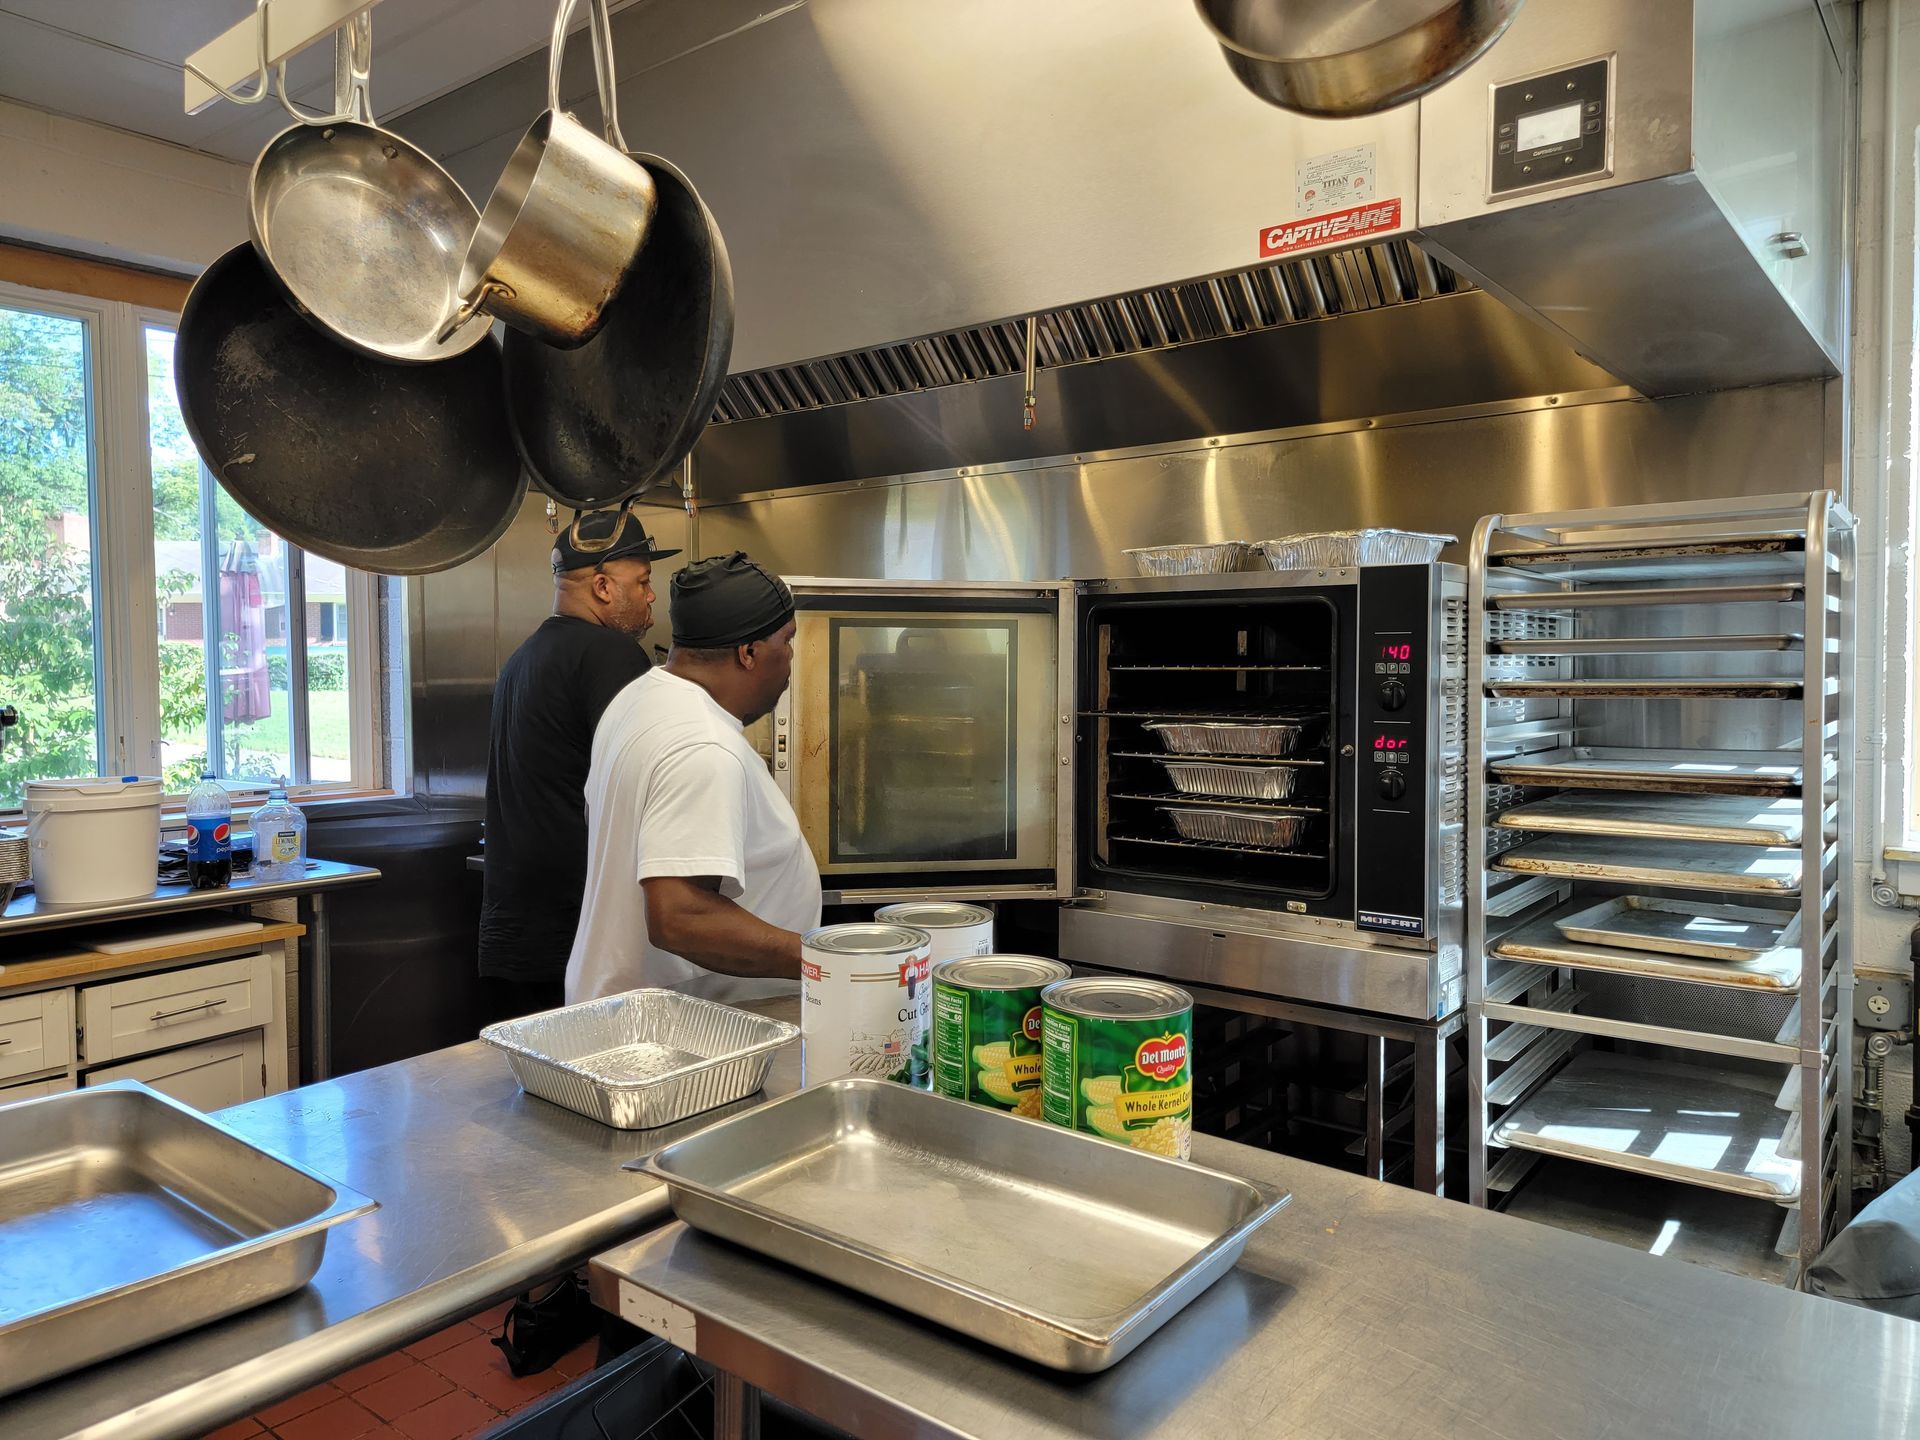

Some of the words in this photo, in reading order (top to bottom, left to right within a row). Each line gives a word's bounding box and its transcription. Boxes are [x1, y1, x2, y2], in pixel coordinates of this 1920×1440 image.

[1323, 176, 1349, 189] TITAN
[1266, 205, 1395, 249] CAPTIVEAIRE
[1382, 645, 1410, 660] 140
[1375, 736, 1407, 749] dor
[216, 846, 231, 854] pep
[1360, 915, 1419, 928] MOFFAT
[802, 964, 820, 978] OVER.
[805, 992, 821, 1006] Beans
[898, 1009, 917, 1022] Cut
[1028, 1018, 1041, 1030] De
[1142, 1050, 1158, 1064] Del
[1160, 1045, 1185, 1063] Monte
[1014, 1062, 1041, 1075] Whole
[1156, 1064, 1176, 1075] Quality
[1125, 1101, 1156, 1113] Whole
[1158, 1094, 1182, 1110] Kernel
[1183, 1091, 1191, 1103] Cor
